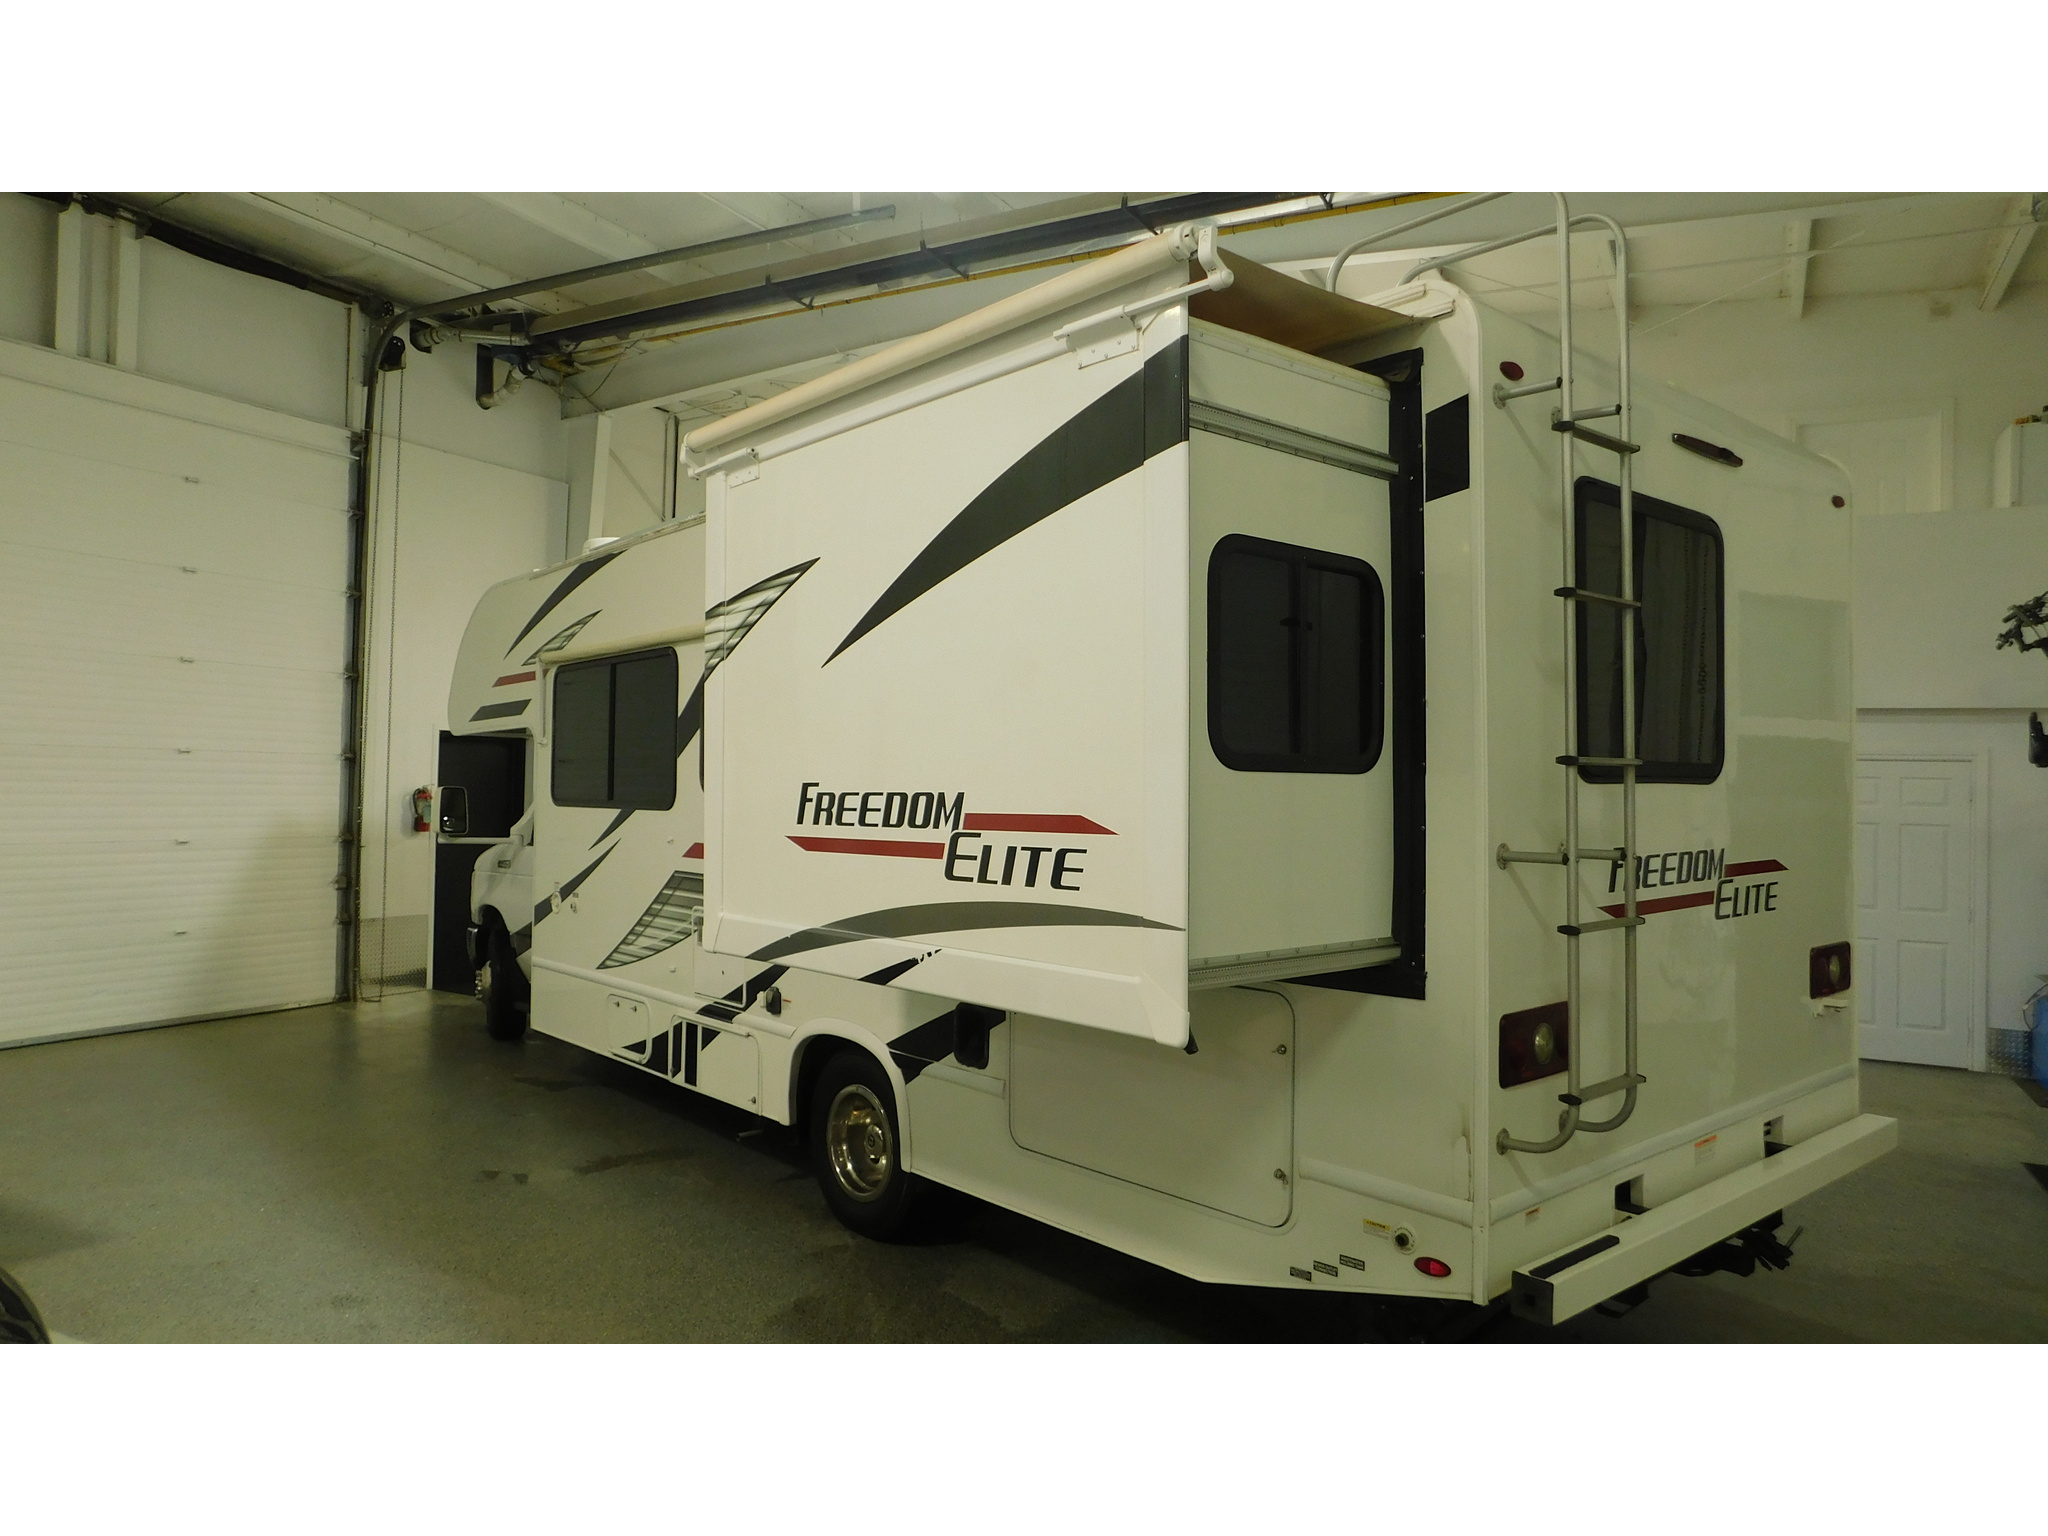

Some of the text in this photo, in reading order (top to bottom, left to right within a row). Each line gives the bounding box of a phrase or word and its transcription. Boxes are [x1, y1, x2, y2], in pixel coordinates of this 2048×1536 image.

[796, 782, 965, 833] FREEDOM
[944, 832, 1087, 891] ELITE
[1715, 879, 1778, 920] ELITE
